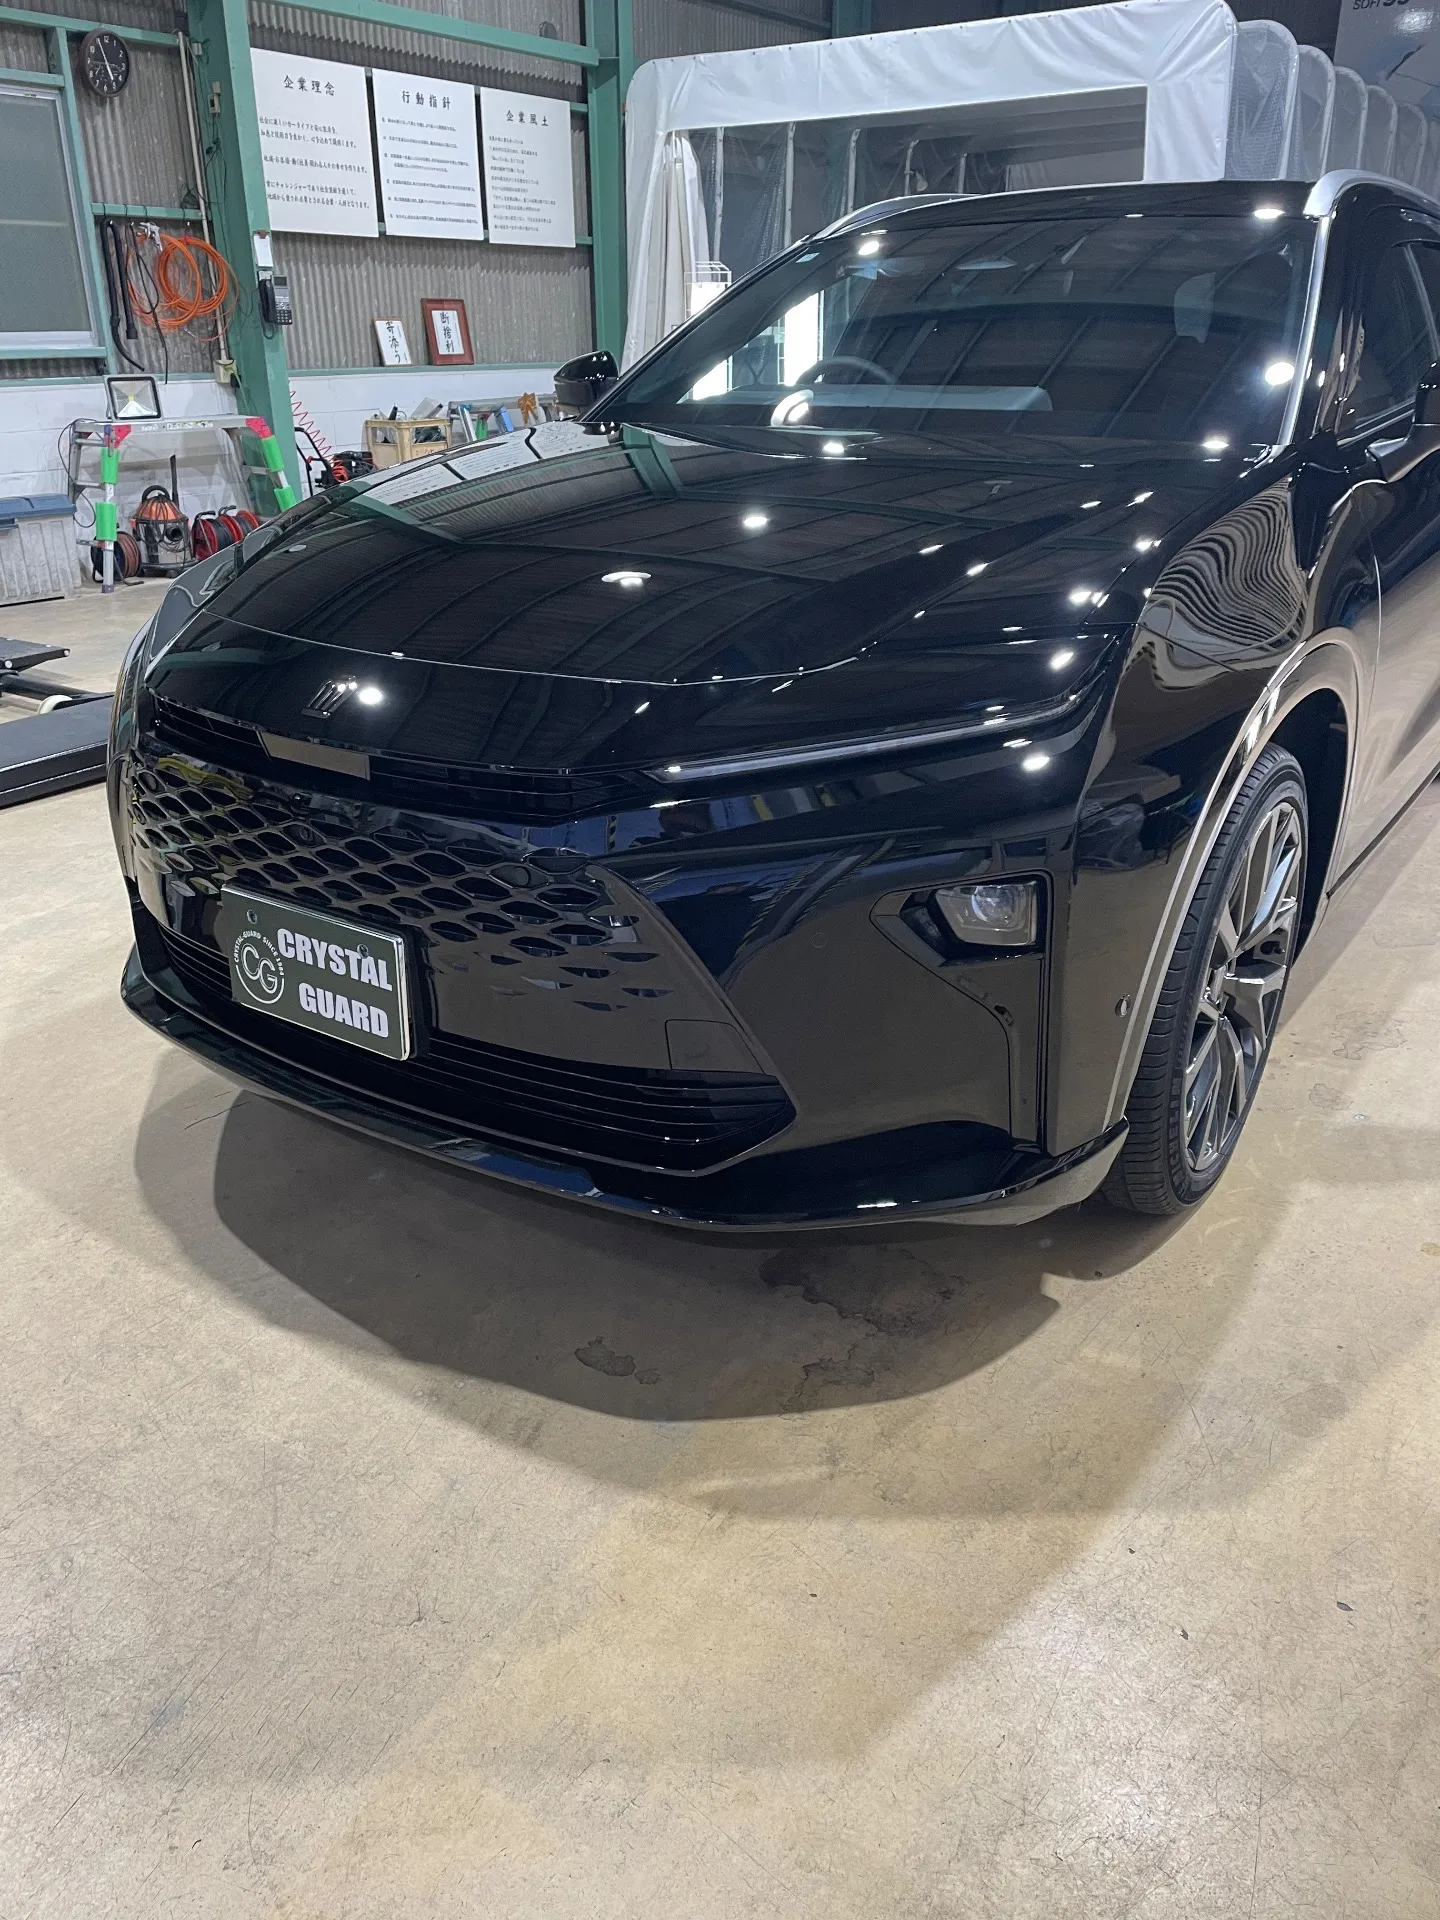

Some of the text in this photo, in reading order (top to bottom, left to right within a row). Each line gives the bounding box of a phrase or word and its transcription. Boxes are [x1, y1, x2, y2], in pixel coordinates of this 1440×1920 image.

[283, 74, 335, 97] 企業理念
[401, 90, 451, 110] 行動指針
[506, 109, 549, 127] 企業風土
[262, 936, 279, 957] SINCE
[277, 928, 393, 992] CRYSTAL
[241, 943, 278, 994] CG
[298, 982, 389, 1038] GUARD
[1168, 1077, 1187, 1188] MICHELIN
